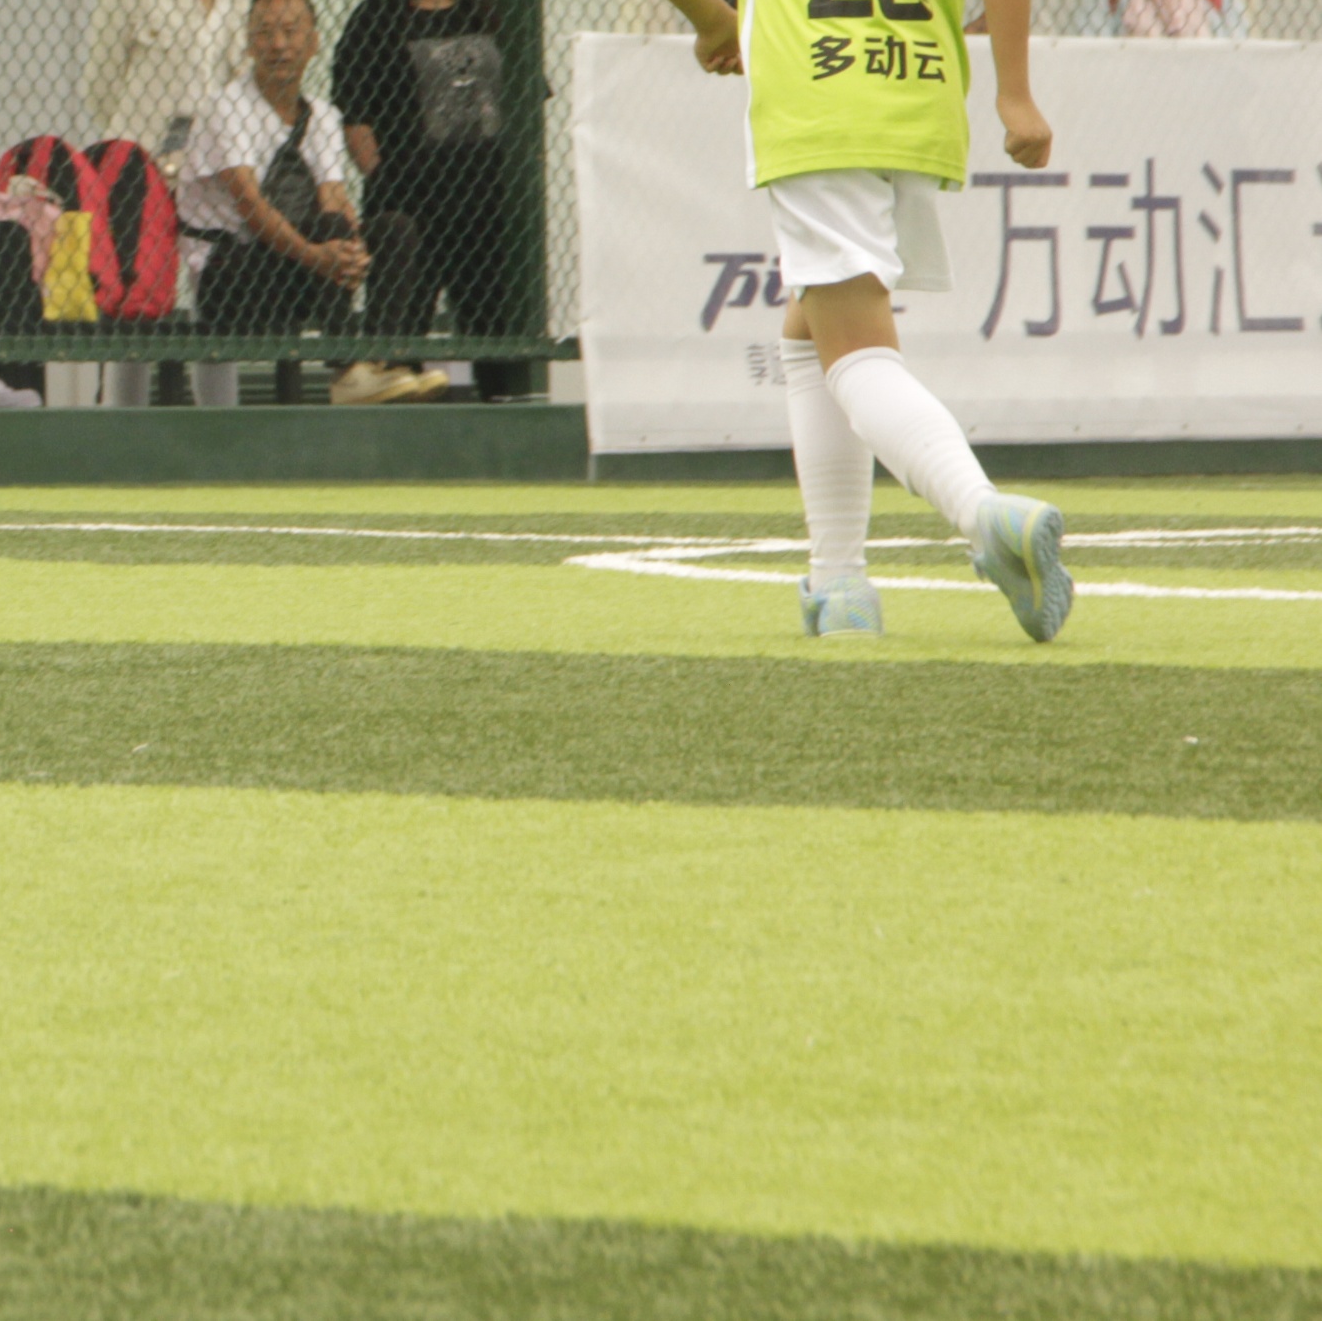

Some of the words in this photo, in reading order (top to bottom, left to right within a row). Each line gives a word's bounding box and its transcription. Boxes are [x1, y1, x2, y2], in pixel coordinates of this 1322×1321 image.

[810, 35, 946, 83] 多动云
[970, 157, 1322, 339] 万动汇
